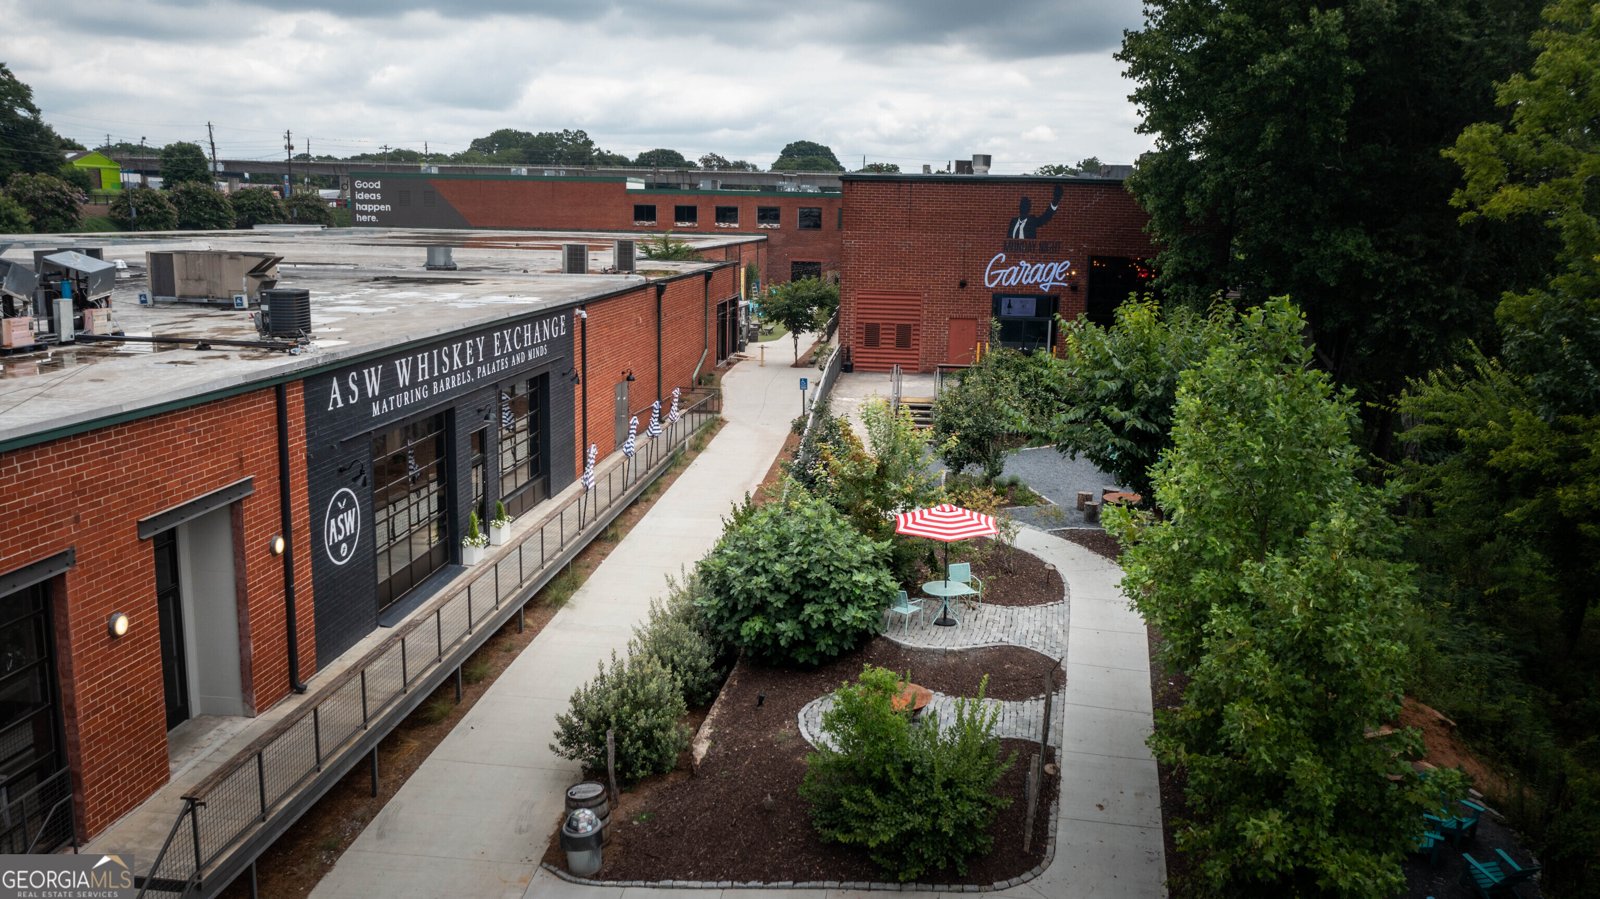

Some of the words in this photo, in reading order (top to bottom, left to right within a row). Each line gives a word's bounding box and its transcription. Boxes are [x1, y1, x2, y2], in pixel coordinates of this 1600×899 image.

[354, 180, 381, 189] Good
[355, 191, 382, 200] ideas
[356, 202, 391, 212] happen
[356, 214, 379, 222] here.
[984, 253, 1071, 292] Garage
[328, 364, 384, 411] ASW
[395, 336, 485, 388] WHISKEY
[493, 315, 566, 357] EXCHANGE
[372, 385, 429, 417] MATURING
[477, 357, 509, 379] PALATES
[511, 351, 526, 367] AND
[528, 344, 548, 361] MINDS
[329, 507, 356, 546] ASW
